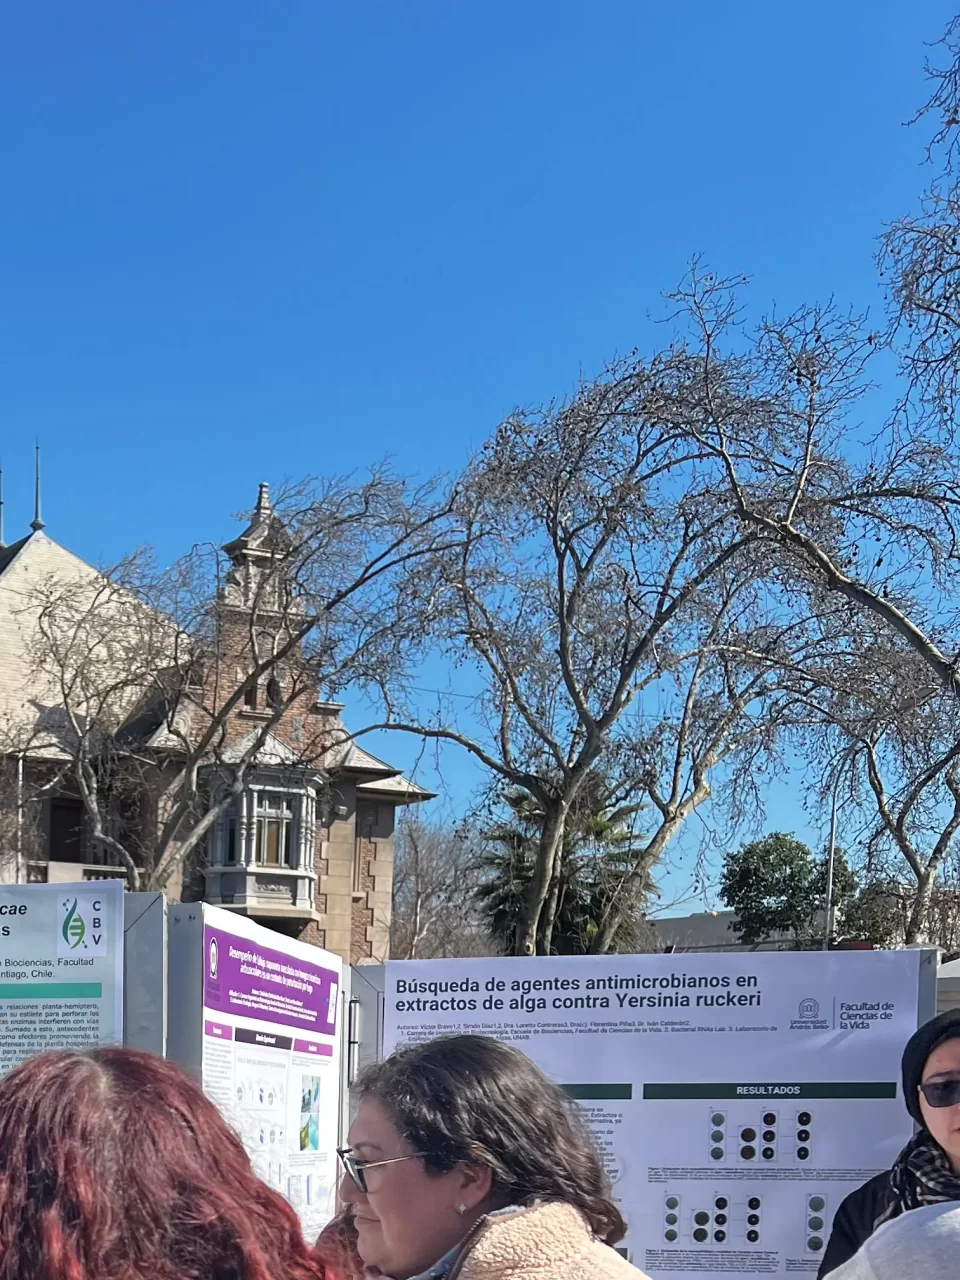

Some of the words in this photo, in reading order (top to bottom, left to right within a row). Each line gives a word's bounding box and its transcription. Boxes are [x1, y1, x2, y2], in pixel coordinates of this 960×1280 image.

[5, 959, 54, 968] Biociencias,
[58, 958, 94, 966] Facultad
[31, 970, 55, 978] Chile.
[396, 977, 479, 996] Búsqueda
[485, 977, 505, 992] de
[511, 977, 580, 994] agentes
[586, 973, 730, 990] antimicrobianos
[736, 975, 757, 987] en
[395, 997, 477, 1011] extractos
[483, 995, 504, 1010] de
[509, 995, 546, 1013] alga
[552, 995, 609, 1009] contra
[616, 992, 690, 1008] Yersinia
[696, 991, 761, 1006] ruckeri
[840, 1002, 880, 1011] Facultad
[881, 1002, 894, 1010] de
[840, 1012, 878, 1020] Ciencias
[880, 1011, 892, 1019] de
[840, 1021, 848, 1029] la
[849, 1021, 870, 1029] Vida
[737, 1086, 800, 1094] RESULTADOS
